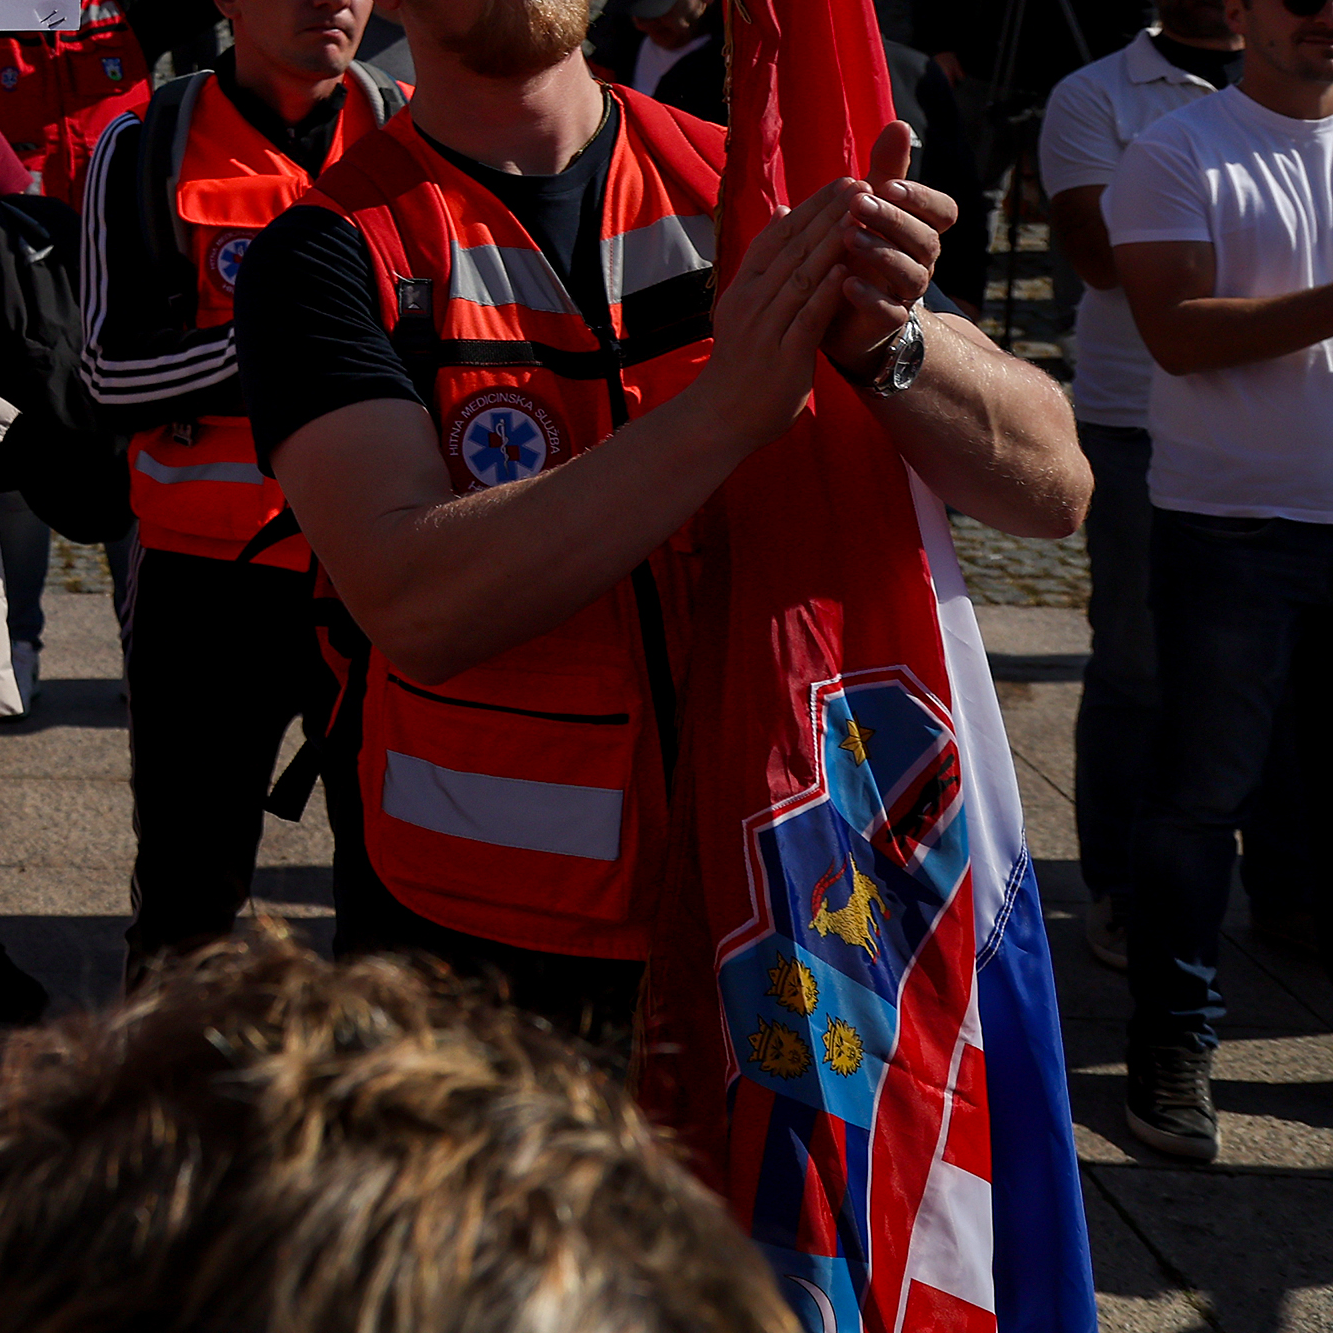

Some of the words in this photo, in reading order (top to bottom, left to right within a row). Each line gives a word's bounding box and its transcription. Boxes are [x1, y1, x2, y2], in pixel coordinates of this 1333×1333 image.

[449, 420, 465, 456] HITNA
[461, 392, 534, 418] MEDICINSKA
[535, 408, 561, 454] SLUŽBA
